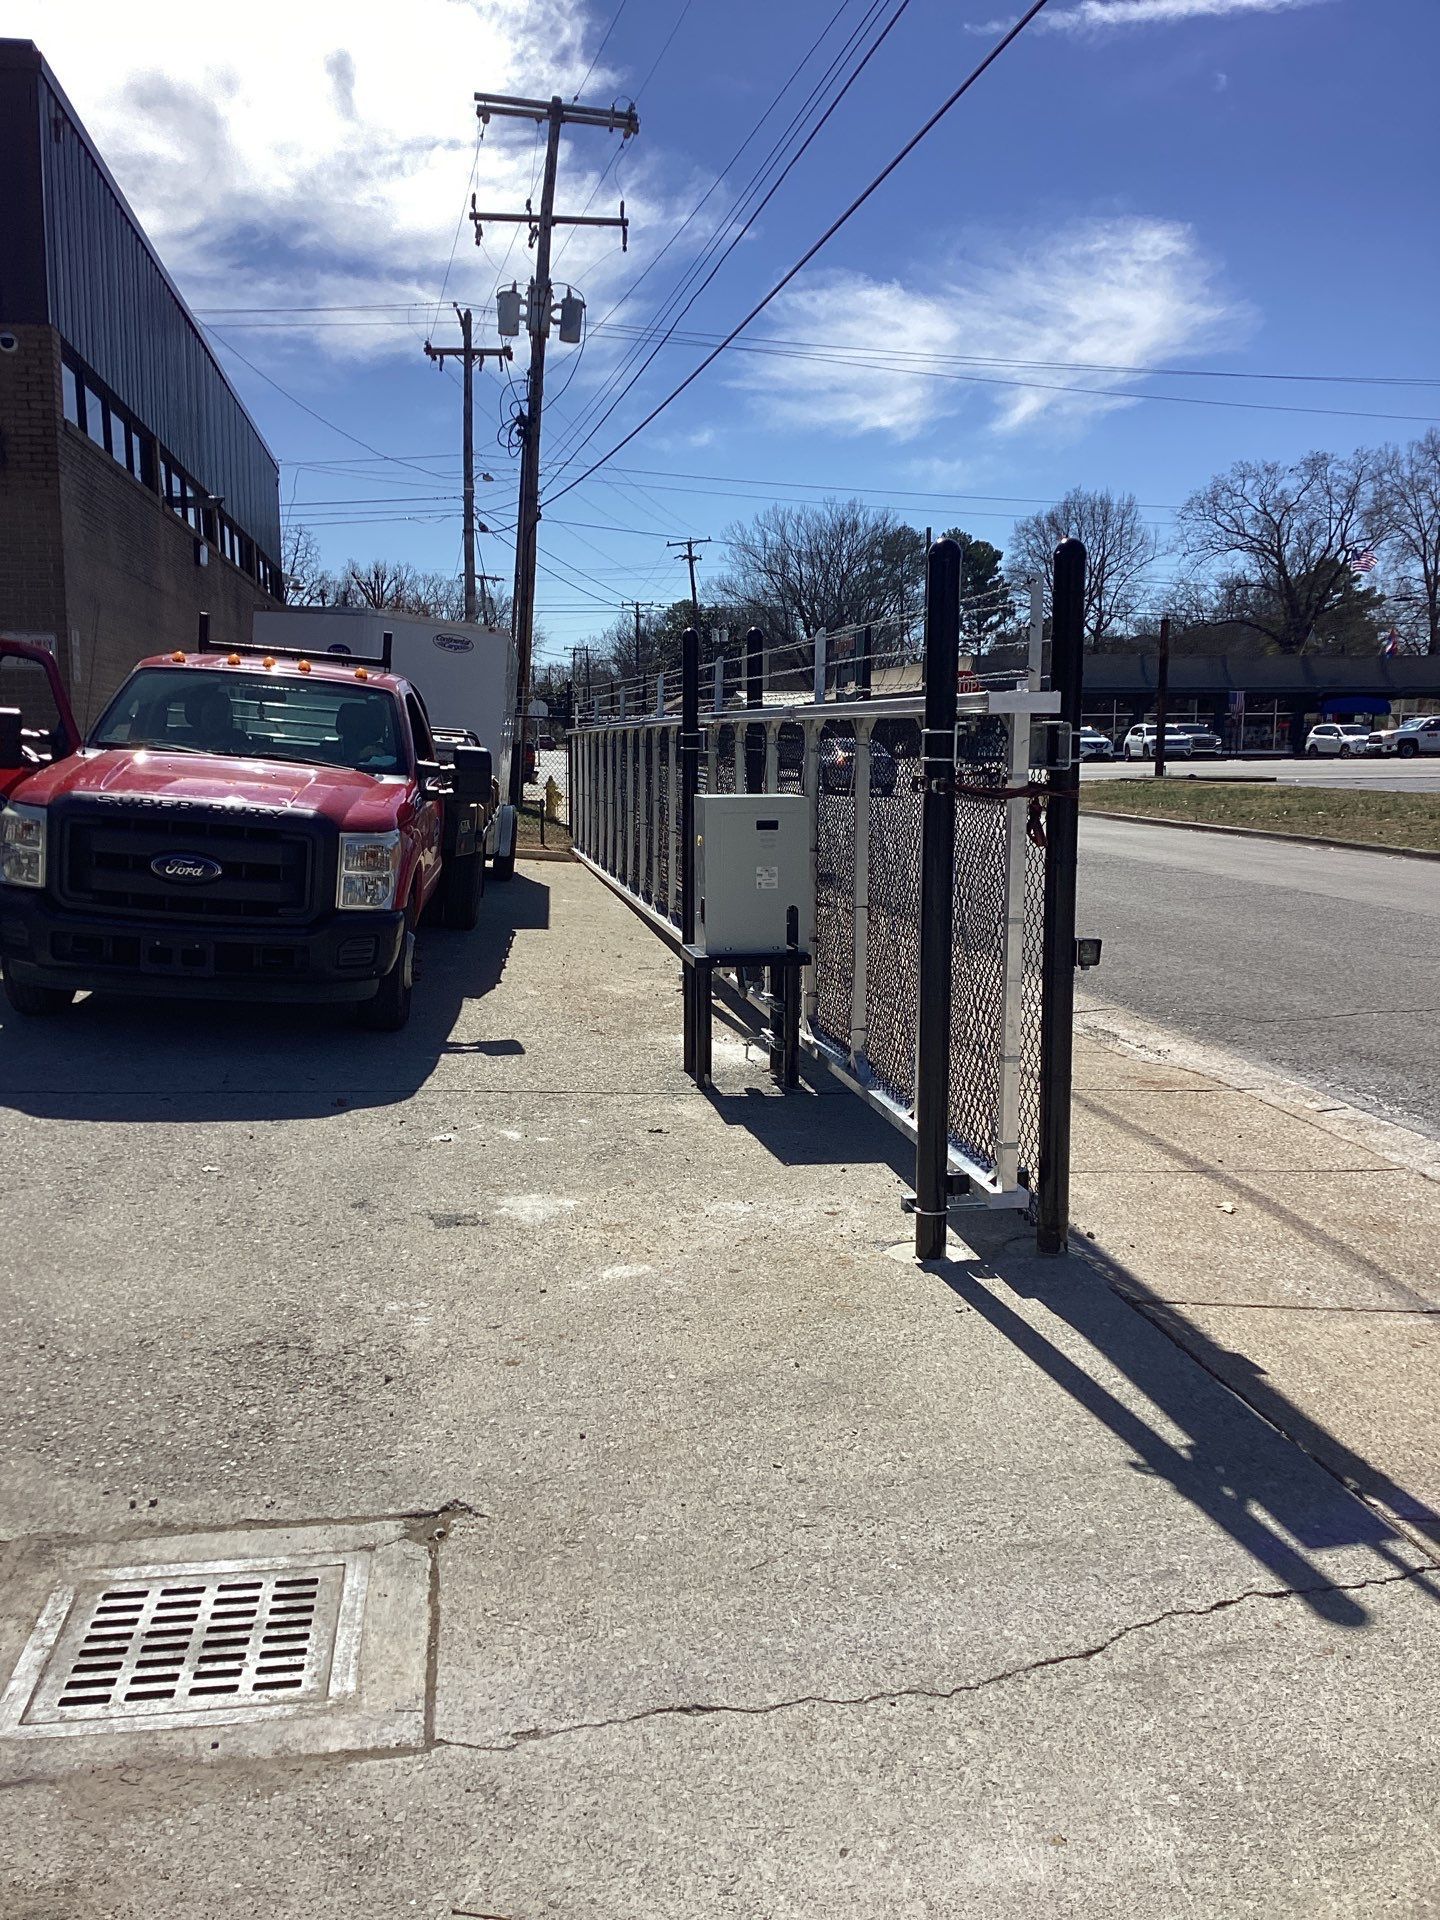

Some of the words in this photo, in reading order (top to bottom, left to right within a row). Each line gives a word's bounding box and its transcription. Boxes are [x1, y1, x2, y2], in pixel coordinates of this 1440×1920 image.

[436, 634, 471, 646] Continental
[957, 679, 979, 693] TOP
[98, 795, 193, 811] SUPER
[208, 803, 289, 818] DUTY
[165, 858, 204, 877] Ford
